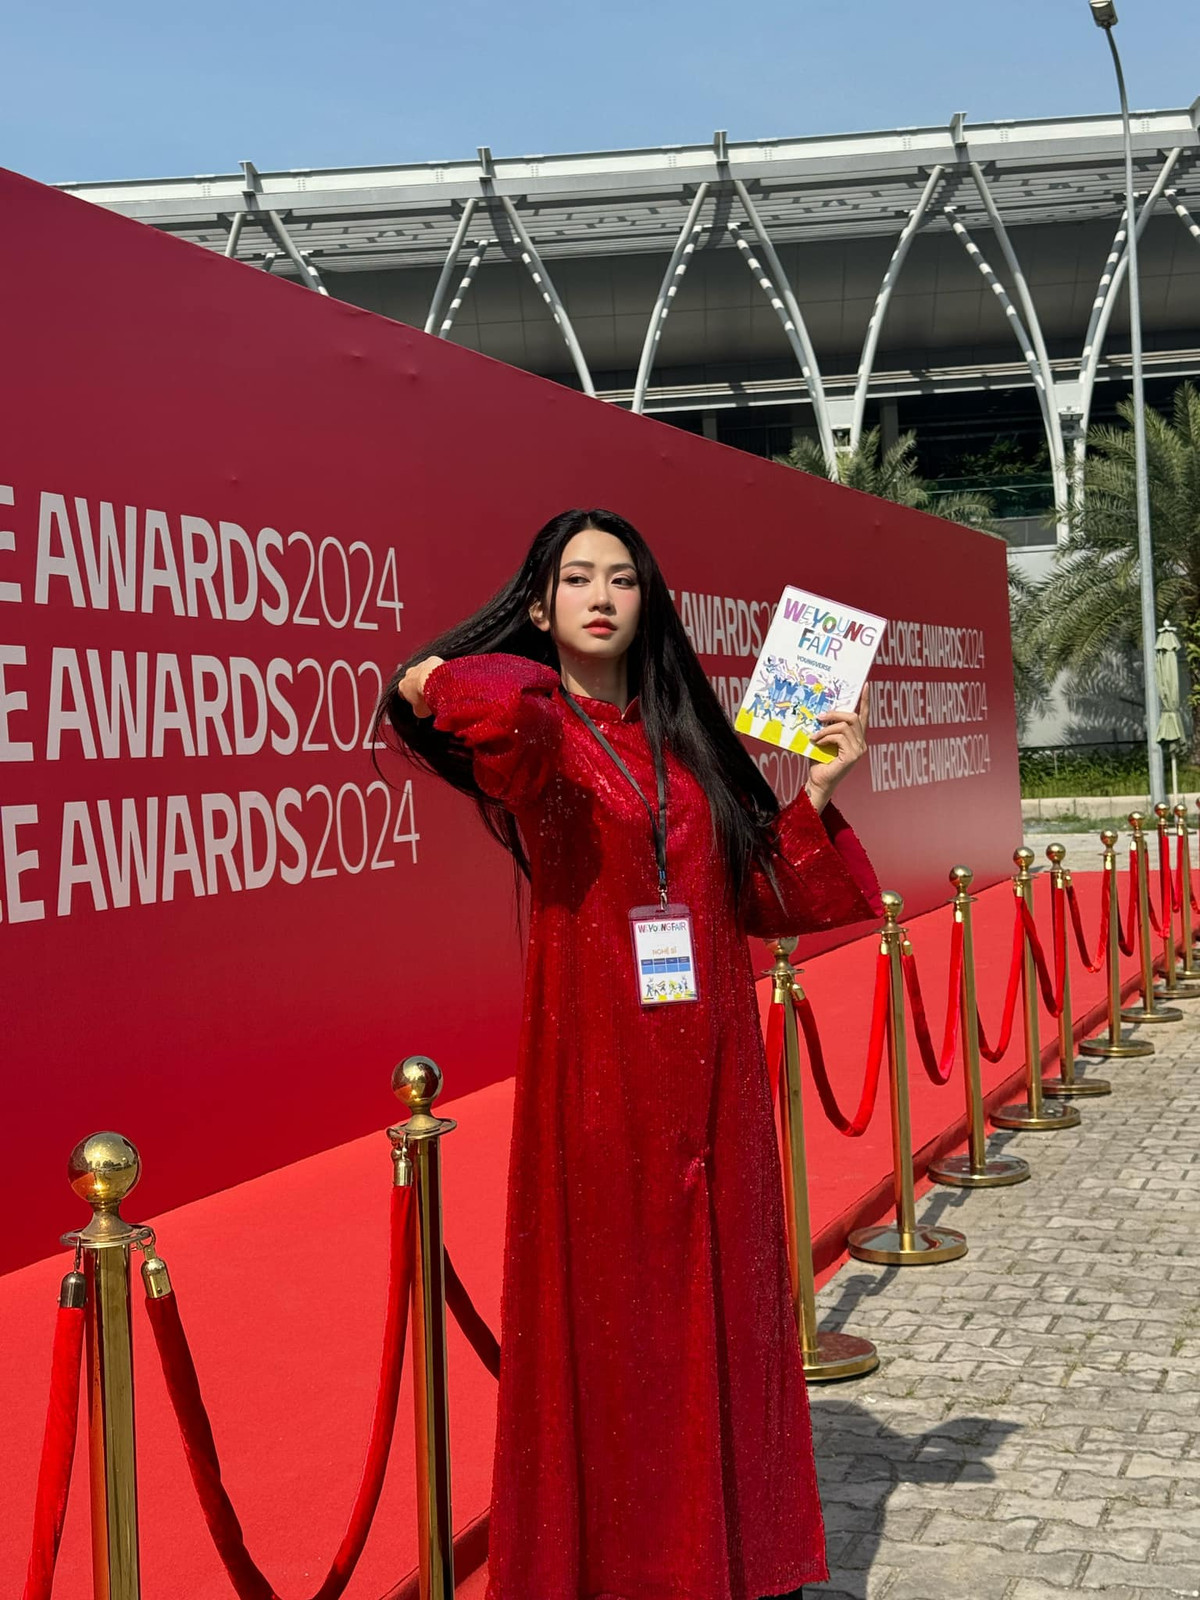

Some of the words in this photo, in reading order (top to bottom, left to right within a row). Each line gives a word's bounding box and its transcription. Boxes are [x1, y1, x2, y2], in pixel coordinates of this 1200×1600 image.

[797, 655, 831, 672] YOUNGVERSE
[798, 628, 843, 661] FAIR
[875, 619, 921, 667] CHOICE
[46, 646, 404, 760] AWARDS202
[868, 740, 929, 792] WECHOICE
